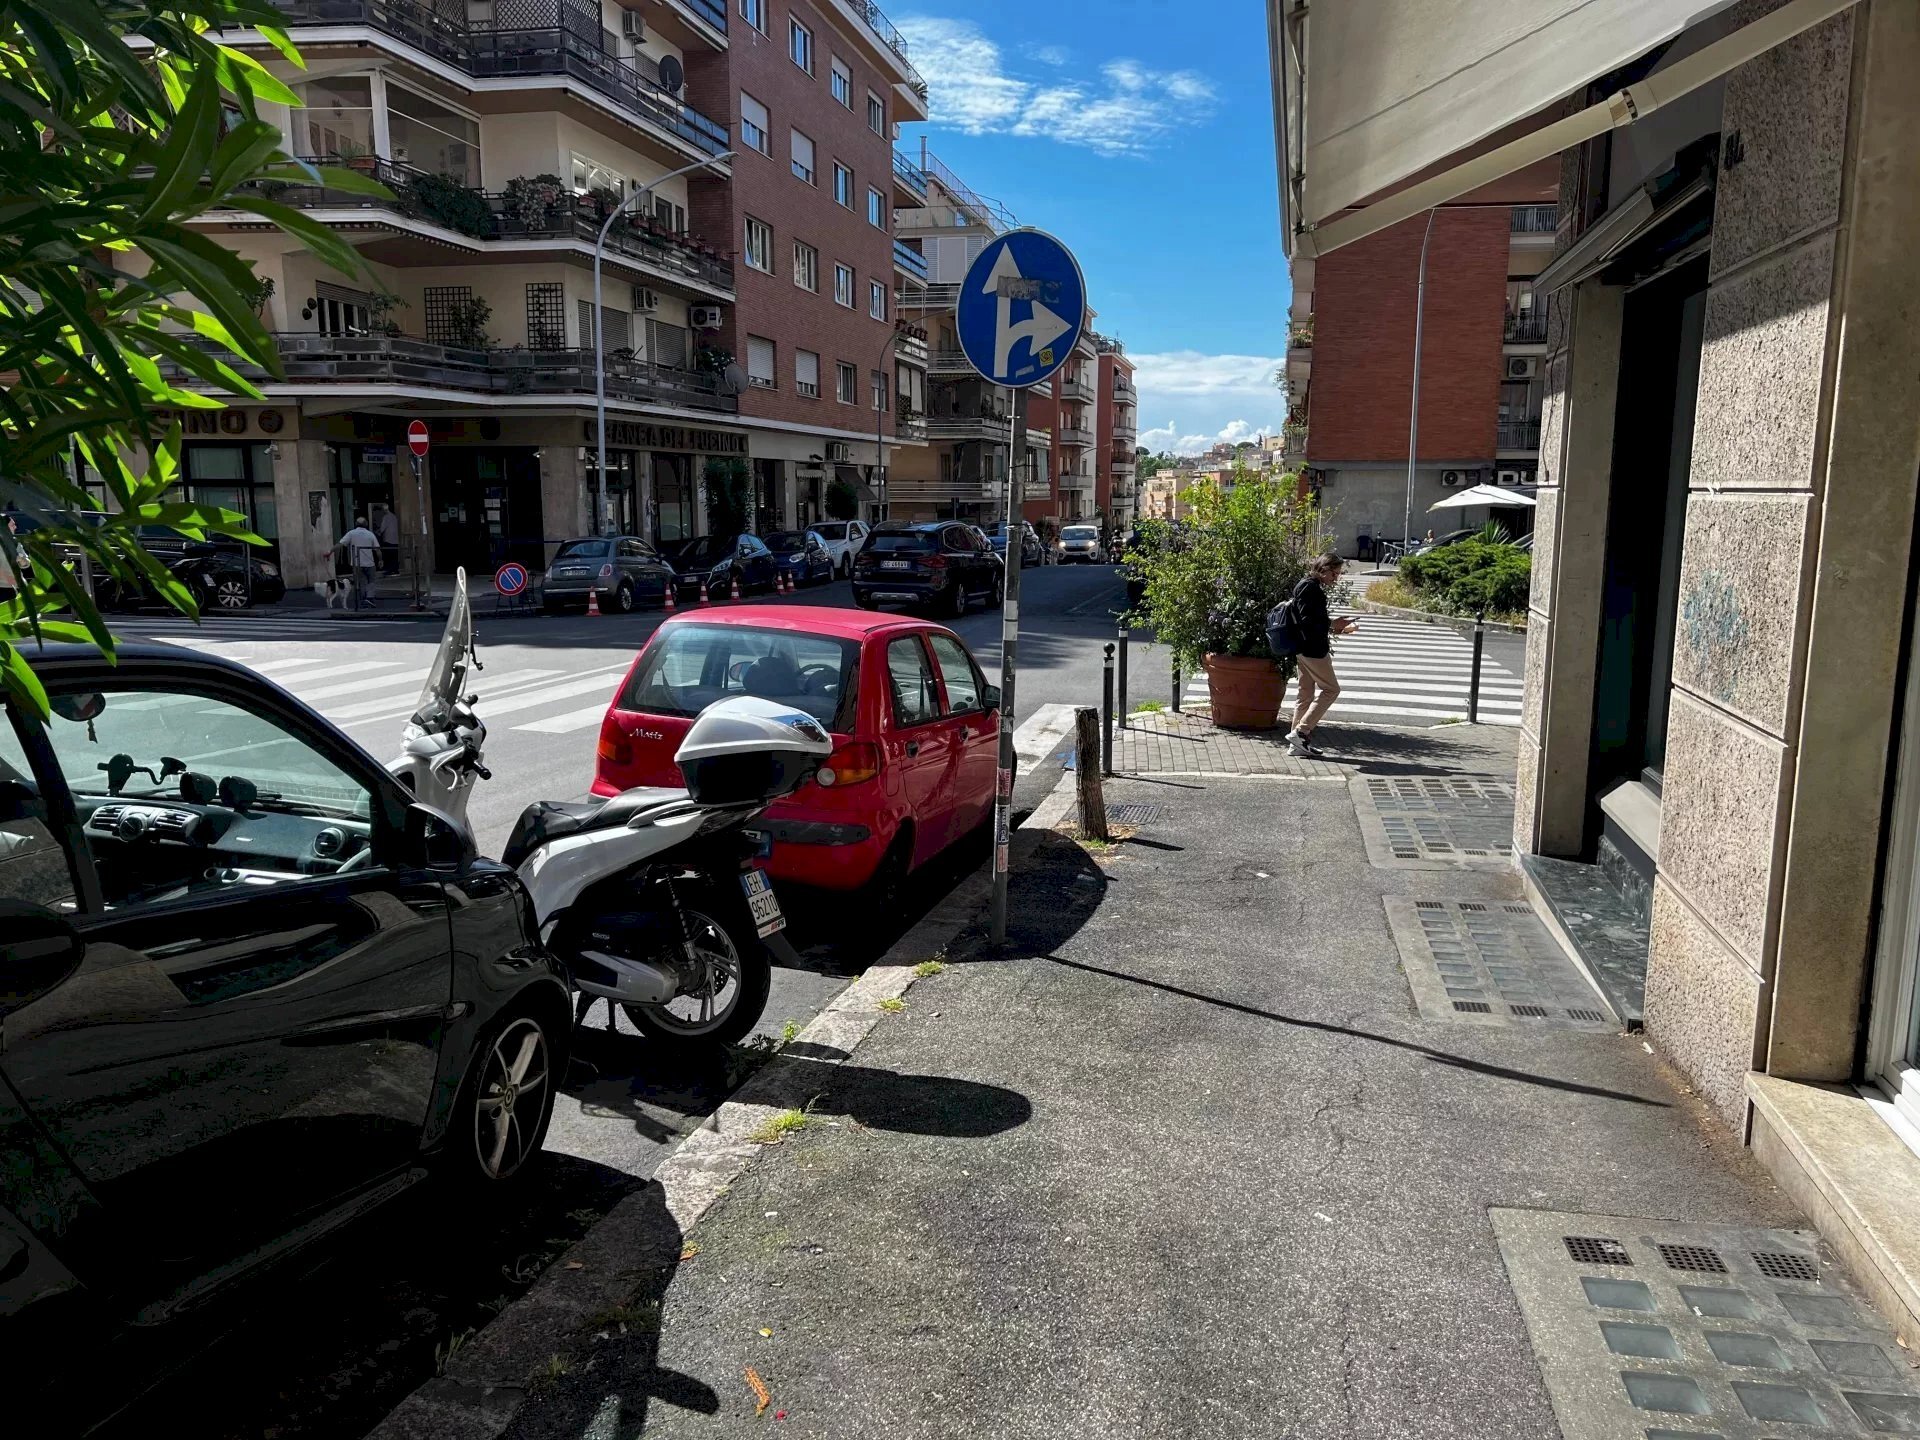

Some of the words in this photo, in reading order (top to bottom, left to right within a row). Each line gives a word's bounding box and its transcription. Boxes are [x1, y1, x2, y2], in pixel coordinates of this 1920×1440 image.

[130, 408, 246, 434] CINO
[629, 728, 663, 740] Matiz
[746, 874, 762, 894] EH
[751, 895, 778, 920] 96210
